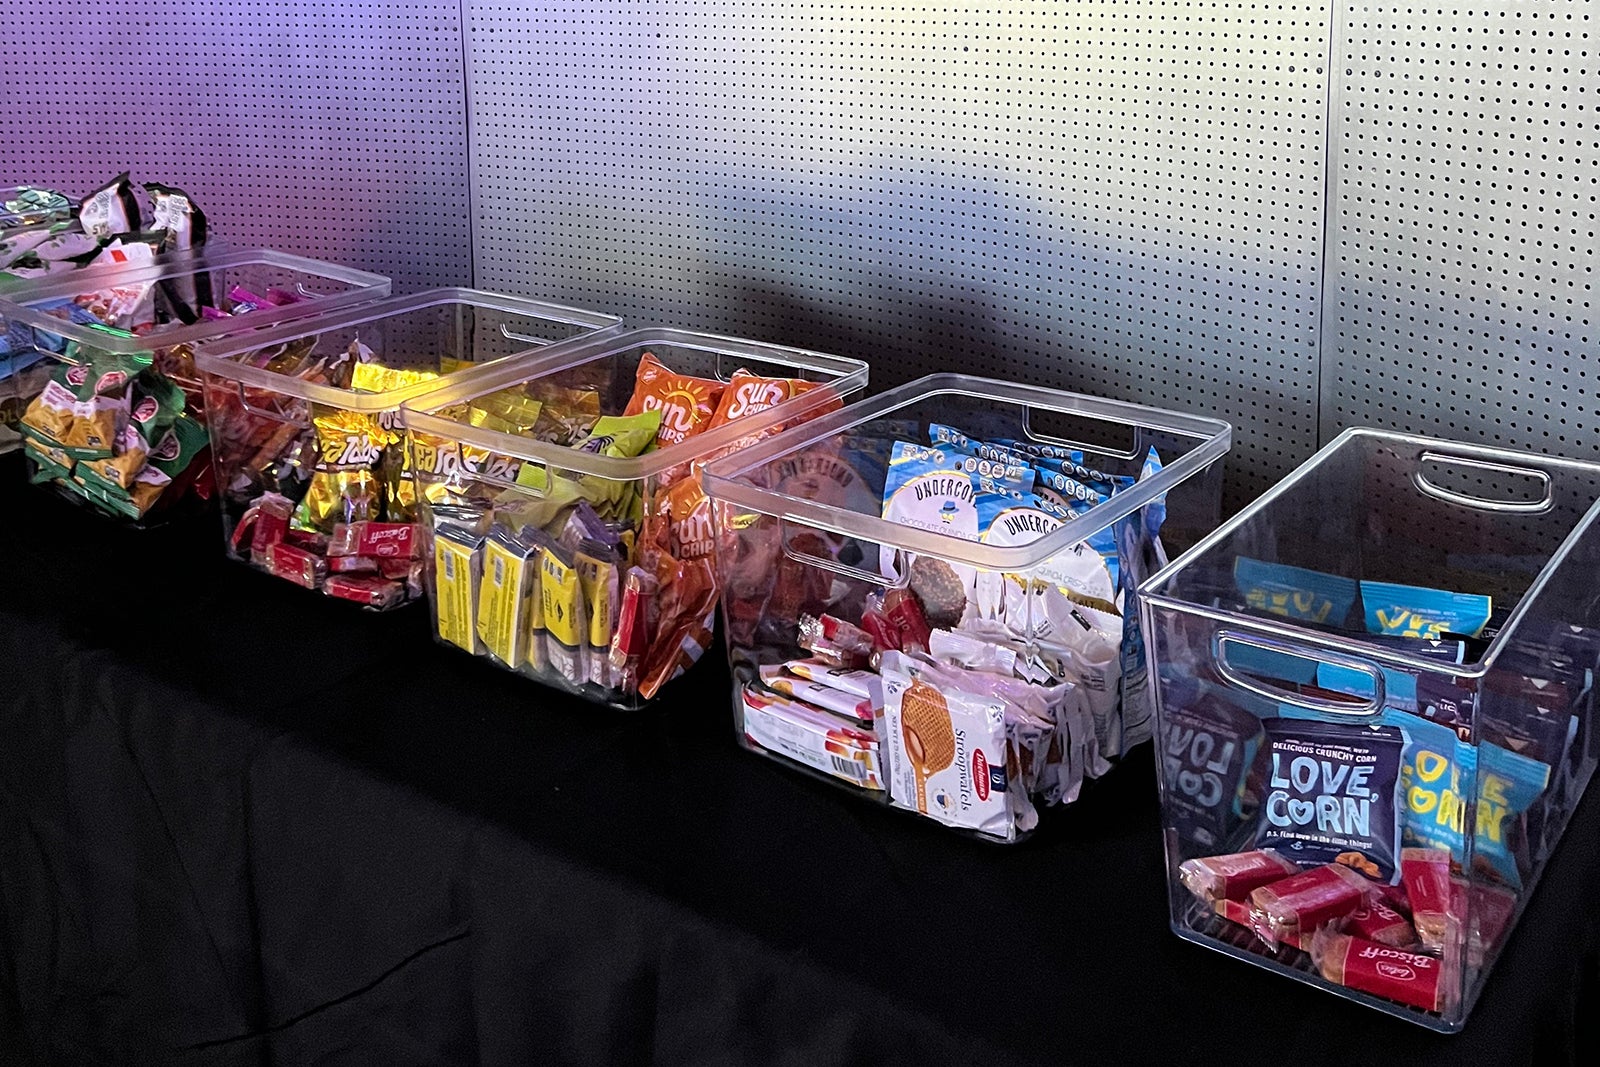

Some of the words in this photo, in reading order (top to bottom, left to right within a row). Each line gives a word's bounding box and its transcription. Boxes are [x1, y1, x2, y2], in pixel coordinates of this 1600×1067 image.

[681, 540, 715, 558] CHIP
[1273, 742, 1314, 754] DELICIOUS
[1315, 748, 1354, 762] CRUNCHY
[1355, 755, 1377, 763] CORN
[955, 728, 972, 811] Stroopwafels
[976, 752, 987, 799] Daelmans
[1266, 790, 1371, 837] CORN
[1319, 835, 1330, 843] the
[1358, 946, 1435, 969] Biscoff
